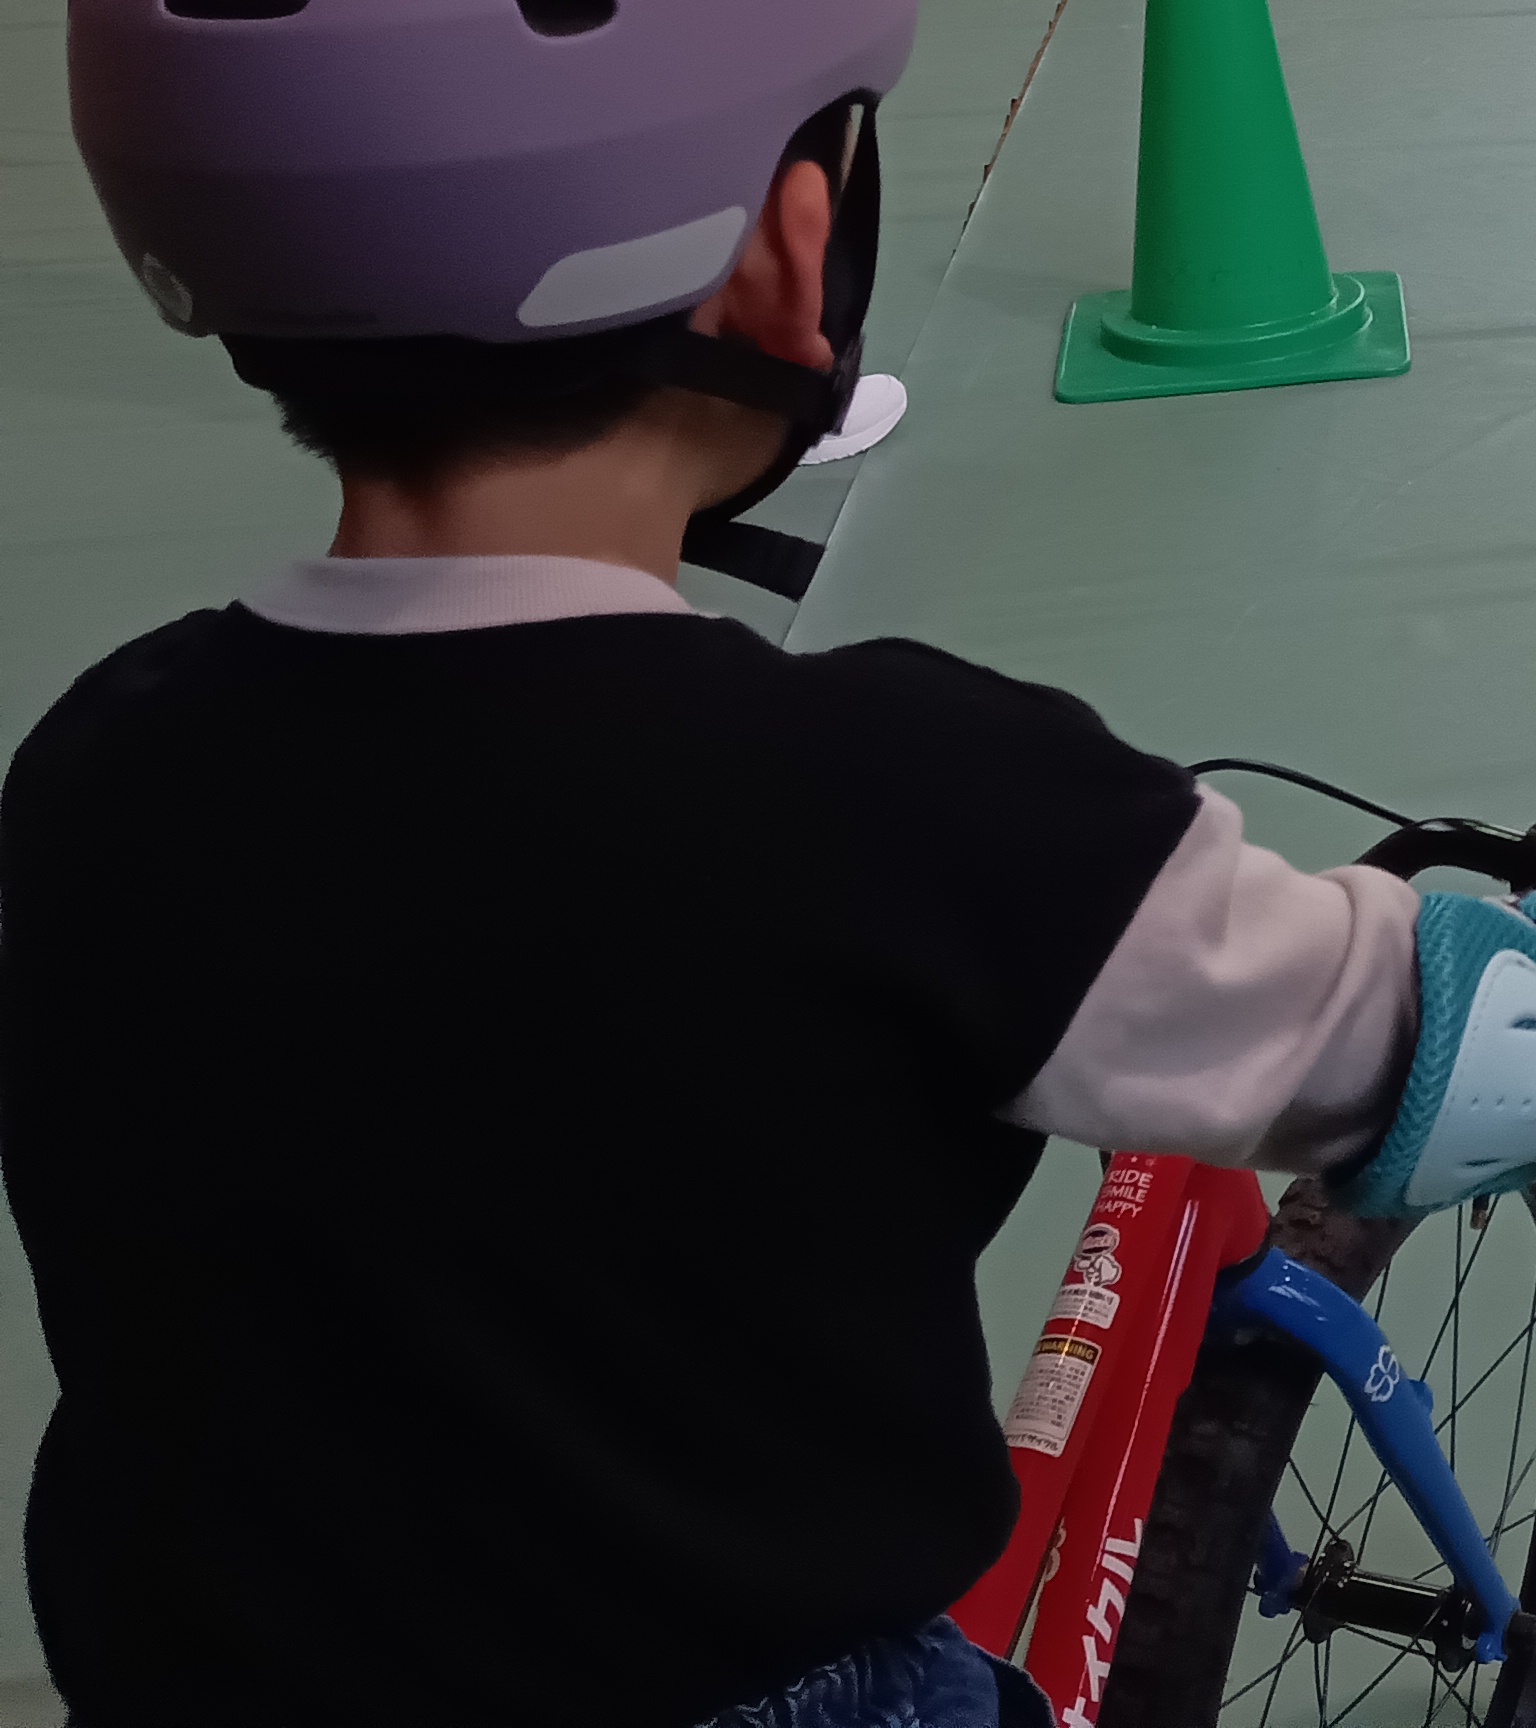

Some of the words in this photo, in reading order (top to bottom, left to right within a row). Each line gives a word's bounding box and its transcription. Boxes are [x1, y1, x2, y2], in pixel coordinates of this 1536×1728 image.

[1108, 1169, 1154, 1189] RIDE
[1101, 1185, 1148, 1203] SMILE
[1096, 1201, 1143, 1218] HAPPY
